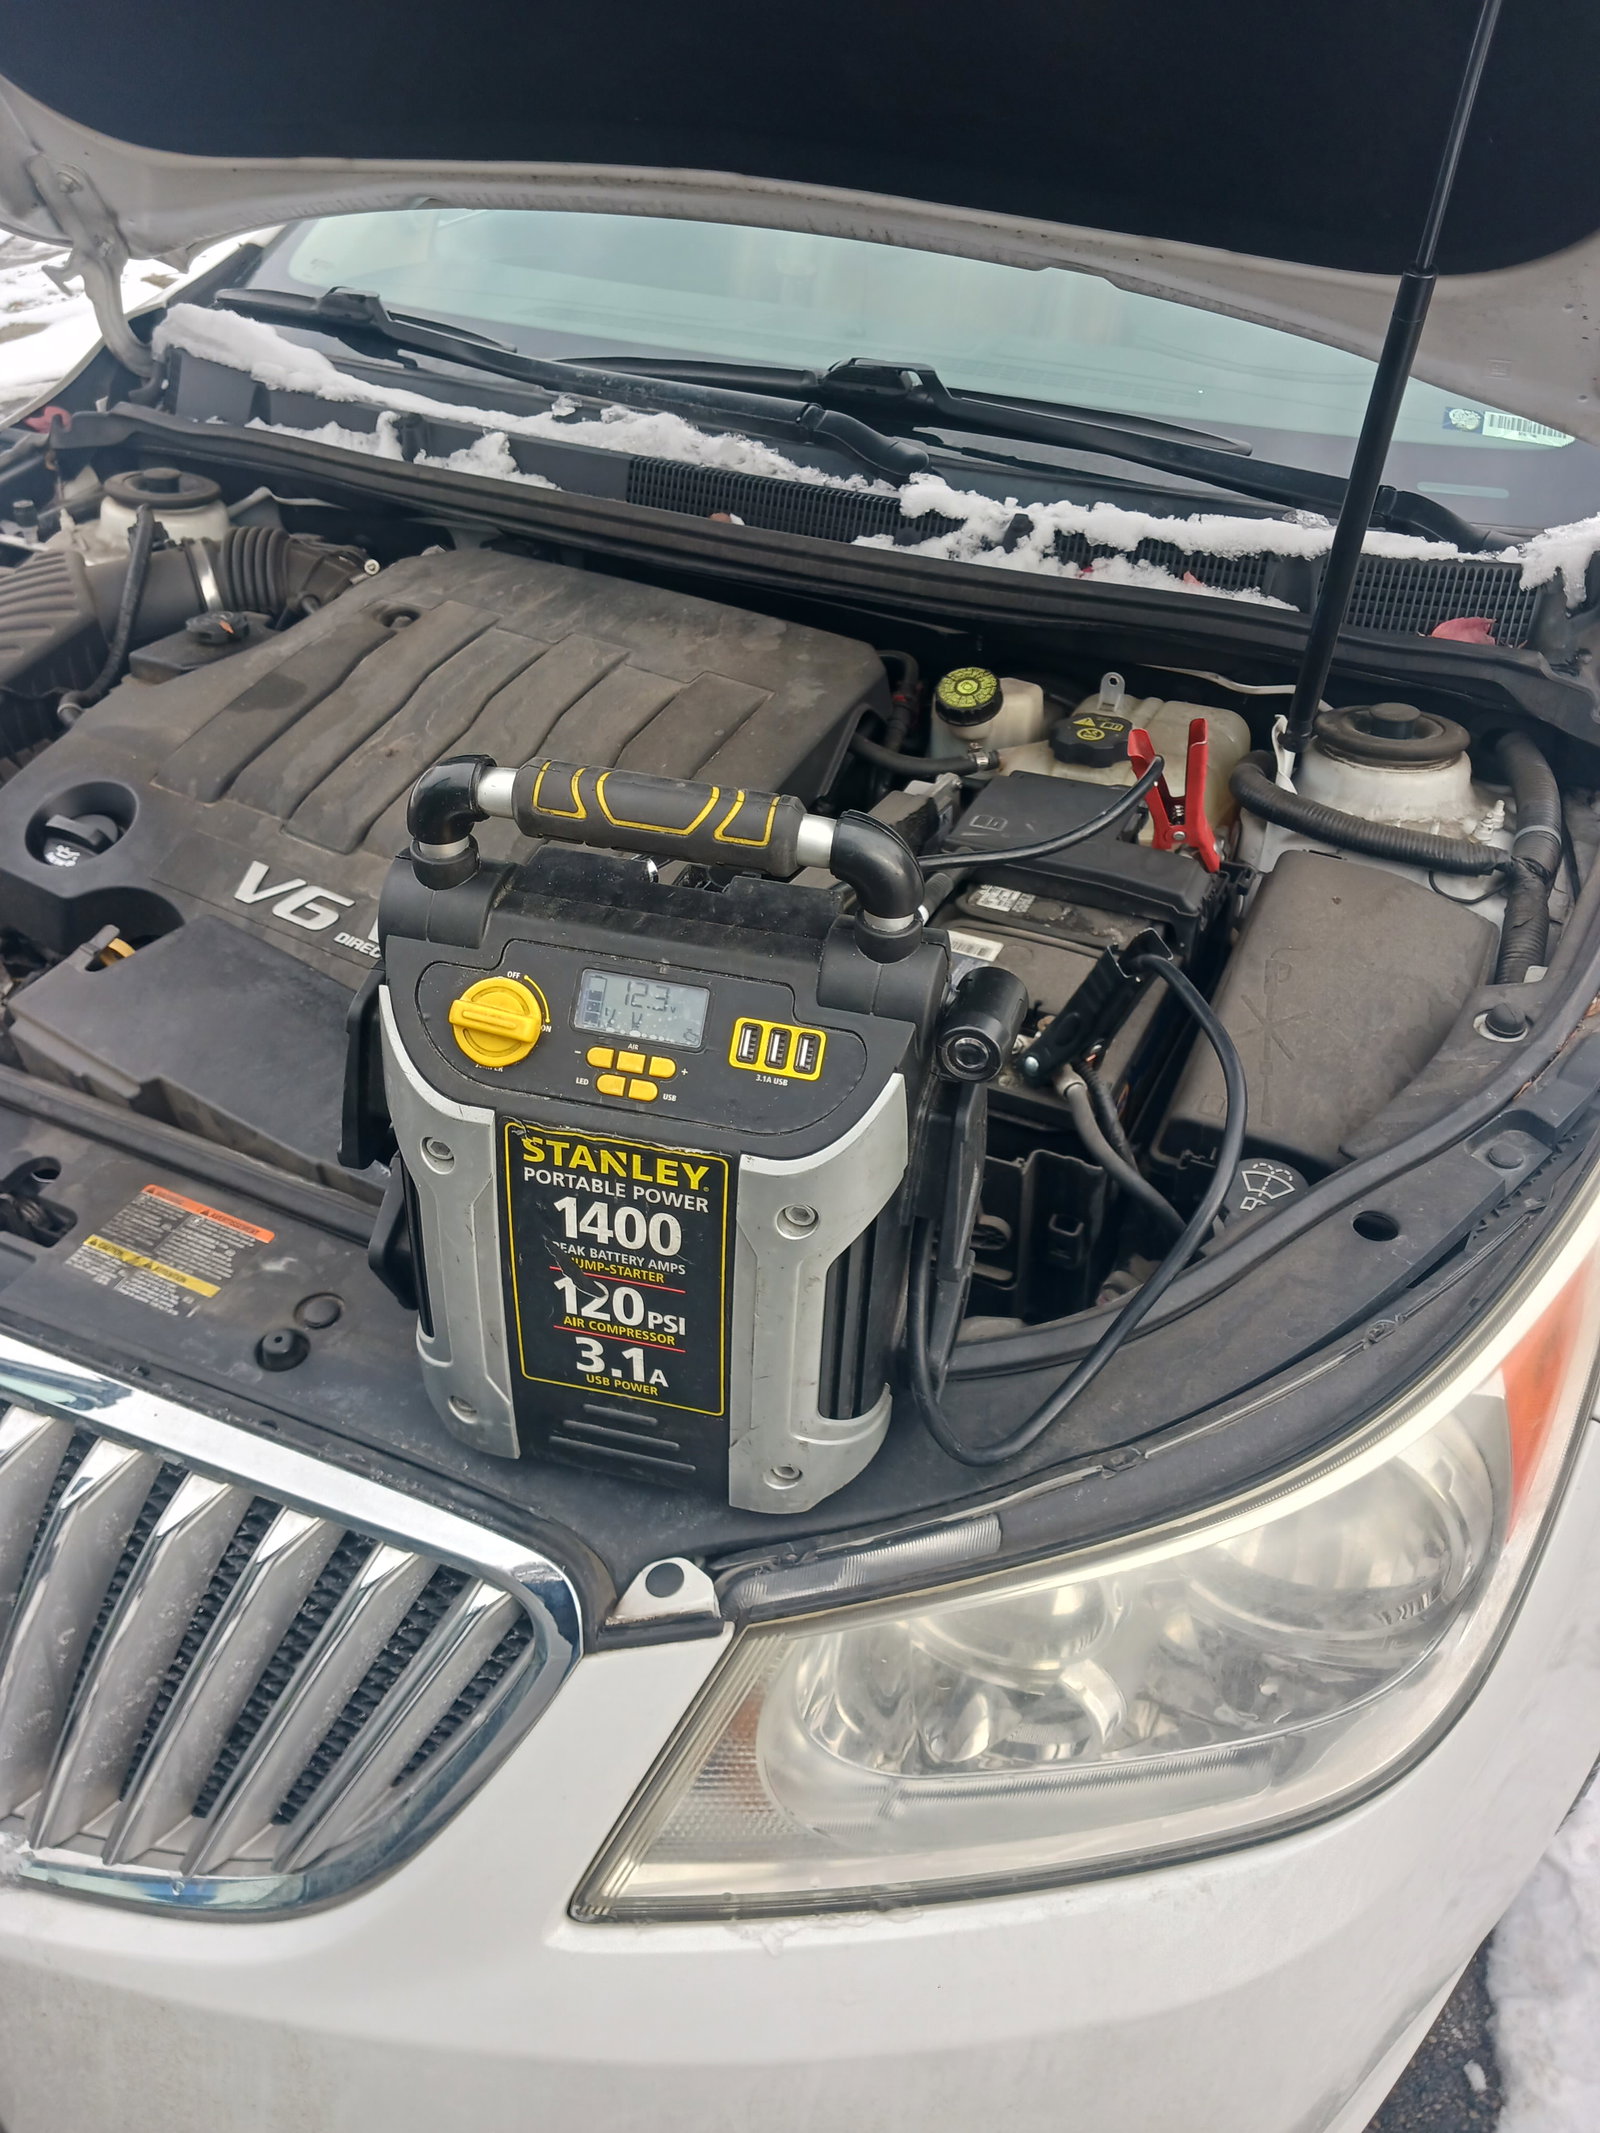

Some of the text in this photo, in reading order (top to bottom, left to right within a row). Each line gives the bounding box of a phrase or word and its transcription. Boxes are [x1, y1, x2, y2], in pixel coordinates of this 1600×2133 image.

[234, 860, 356, 930] V6
[507, 971, 521, 979] OFF
[625, 981, 670, 1012] 12.3
[541, 1025, 552, 1033] ON
[628, 1043, 639, 1051] AIR
[576, 1077, 589, 1086] LED
[756, 1073, 789, 1087] 3.1A USB
[663, 1093, 677, 1102] USB
[521, 1137, 709, 1191] STANLEY
[524, 1167, 709, 1213] PORTABLE POWER
[554, 1196, 682, 1256] 1400
[552, 1240, 686, 1275] EAK BATTERY AMPS
[571, 1257, 665, 1284] UMP-STARTER
[563, 1316, 675, 1346] AIR COMPRESSOR
[586, 1374, 659, 1396] USB POWER
